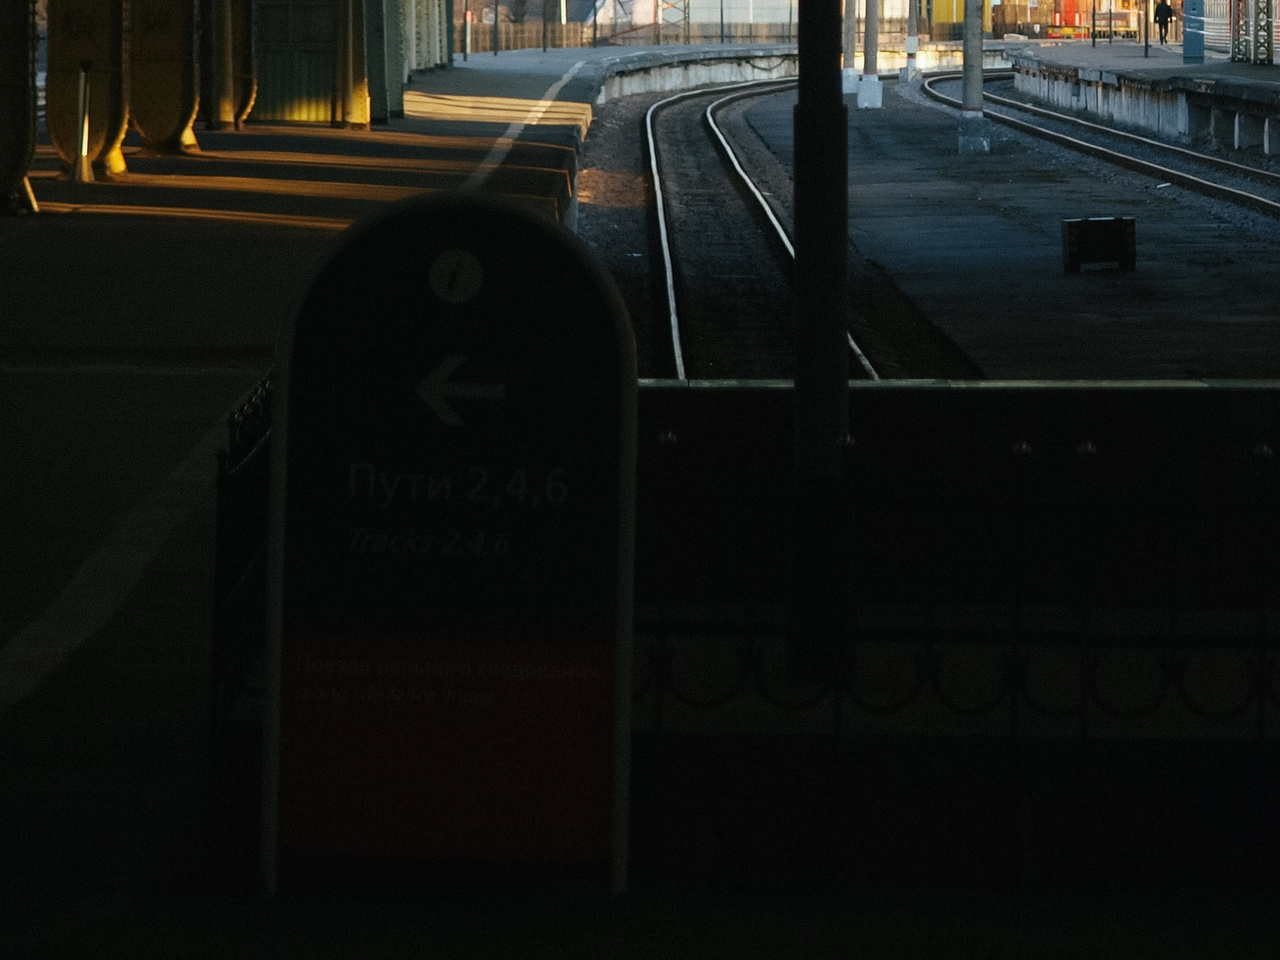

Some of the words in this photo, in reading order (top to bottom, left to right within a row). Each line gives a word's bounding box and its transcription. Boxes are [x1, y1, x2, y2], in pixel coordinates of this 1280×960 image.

[348, 463, 451, 508] Пути
[467, 465, 568, 508] 2,4,6
[349, 527, 434, 554] Tracks
